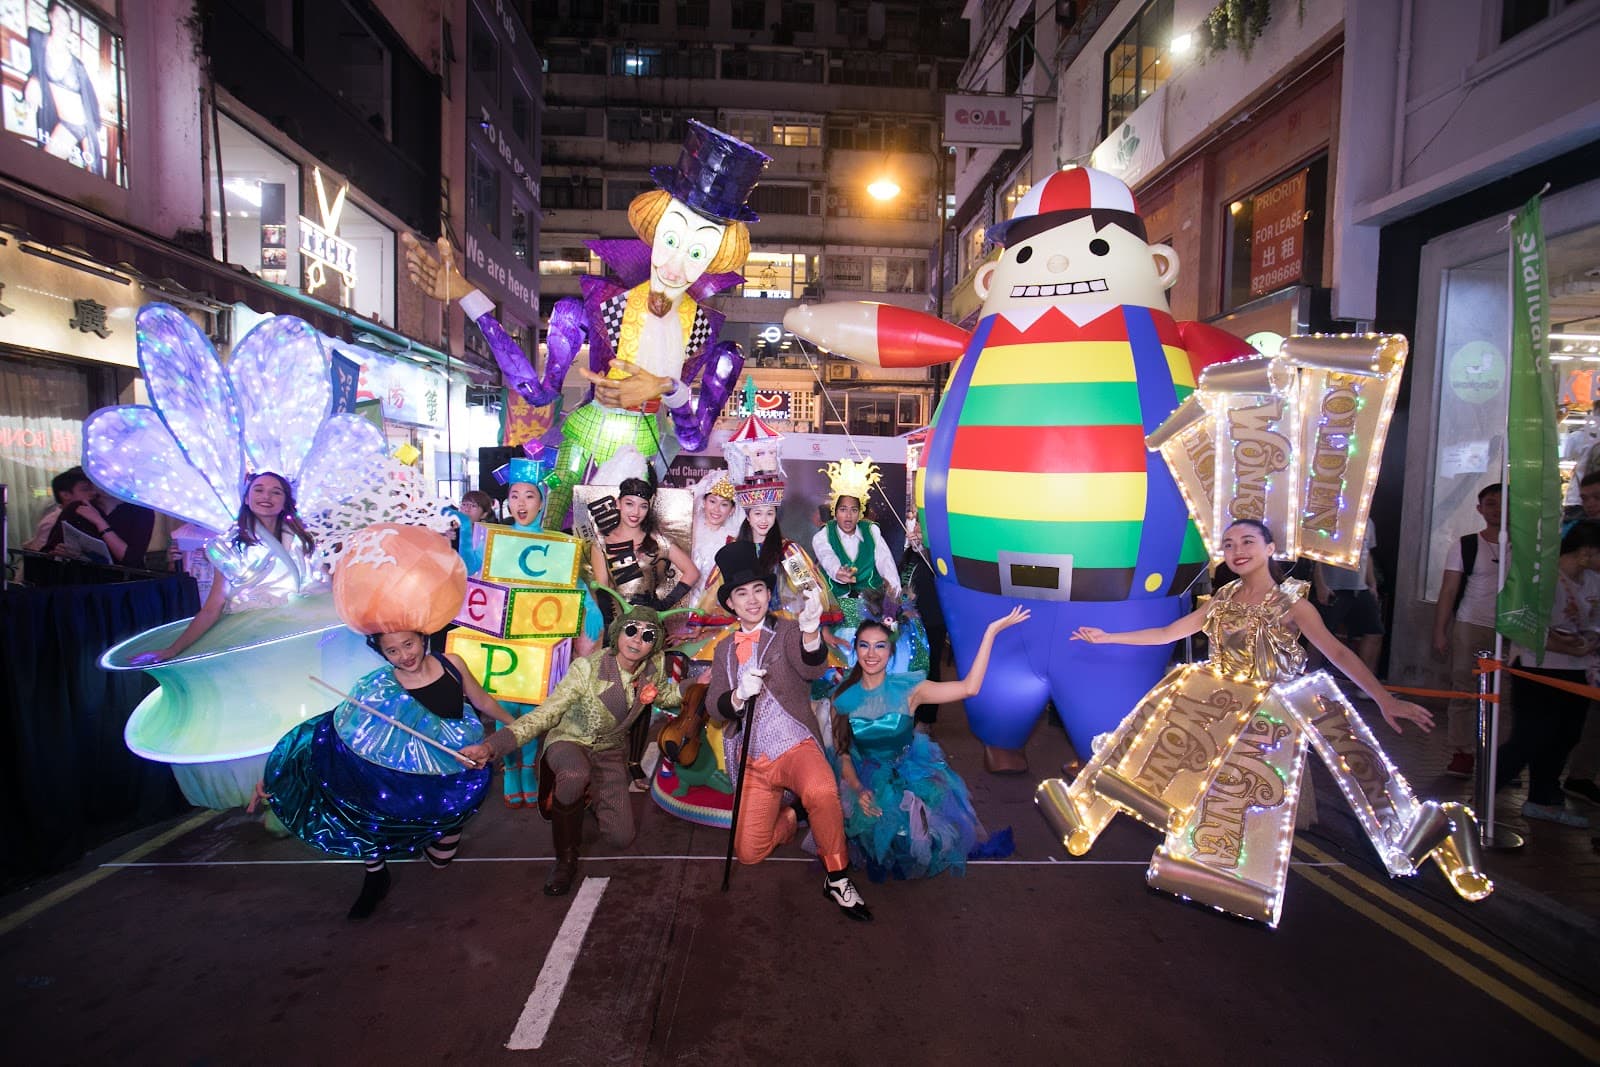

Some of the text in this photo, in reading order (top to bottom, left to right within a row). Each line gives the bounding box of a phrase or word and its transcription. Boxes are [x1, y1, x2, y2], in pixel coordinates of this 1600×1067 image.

[955, 109, 1011, 127] GOAL
[499, 130, 512, 165] be
[1257, 176, 1302, 210] PRIORITY
[1256, 210, 1302, 245] FOR LEASE
[466, 235, 540, 312] We are here to
[1252, 260, 1302, 290] 82096669
[468, 588, 487, 621] e
[481, 643, 518, 694] P
[1134, 689, 1242, 798] WONK
[1311, 694, 1402, 845] WONK
